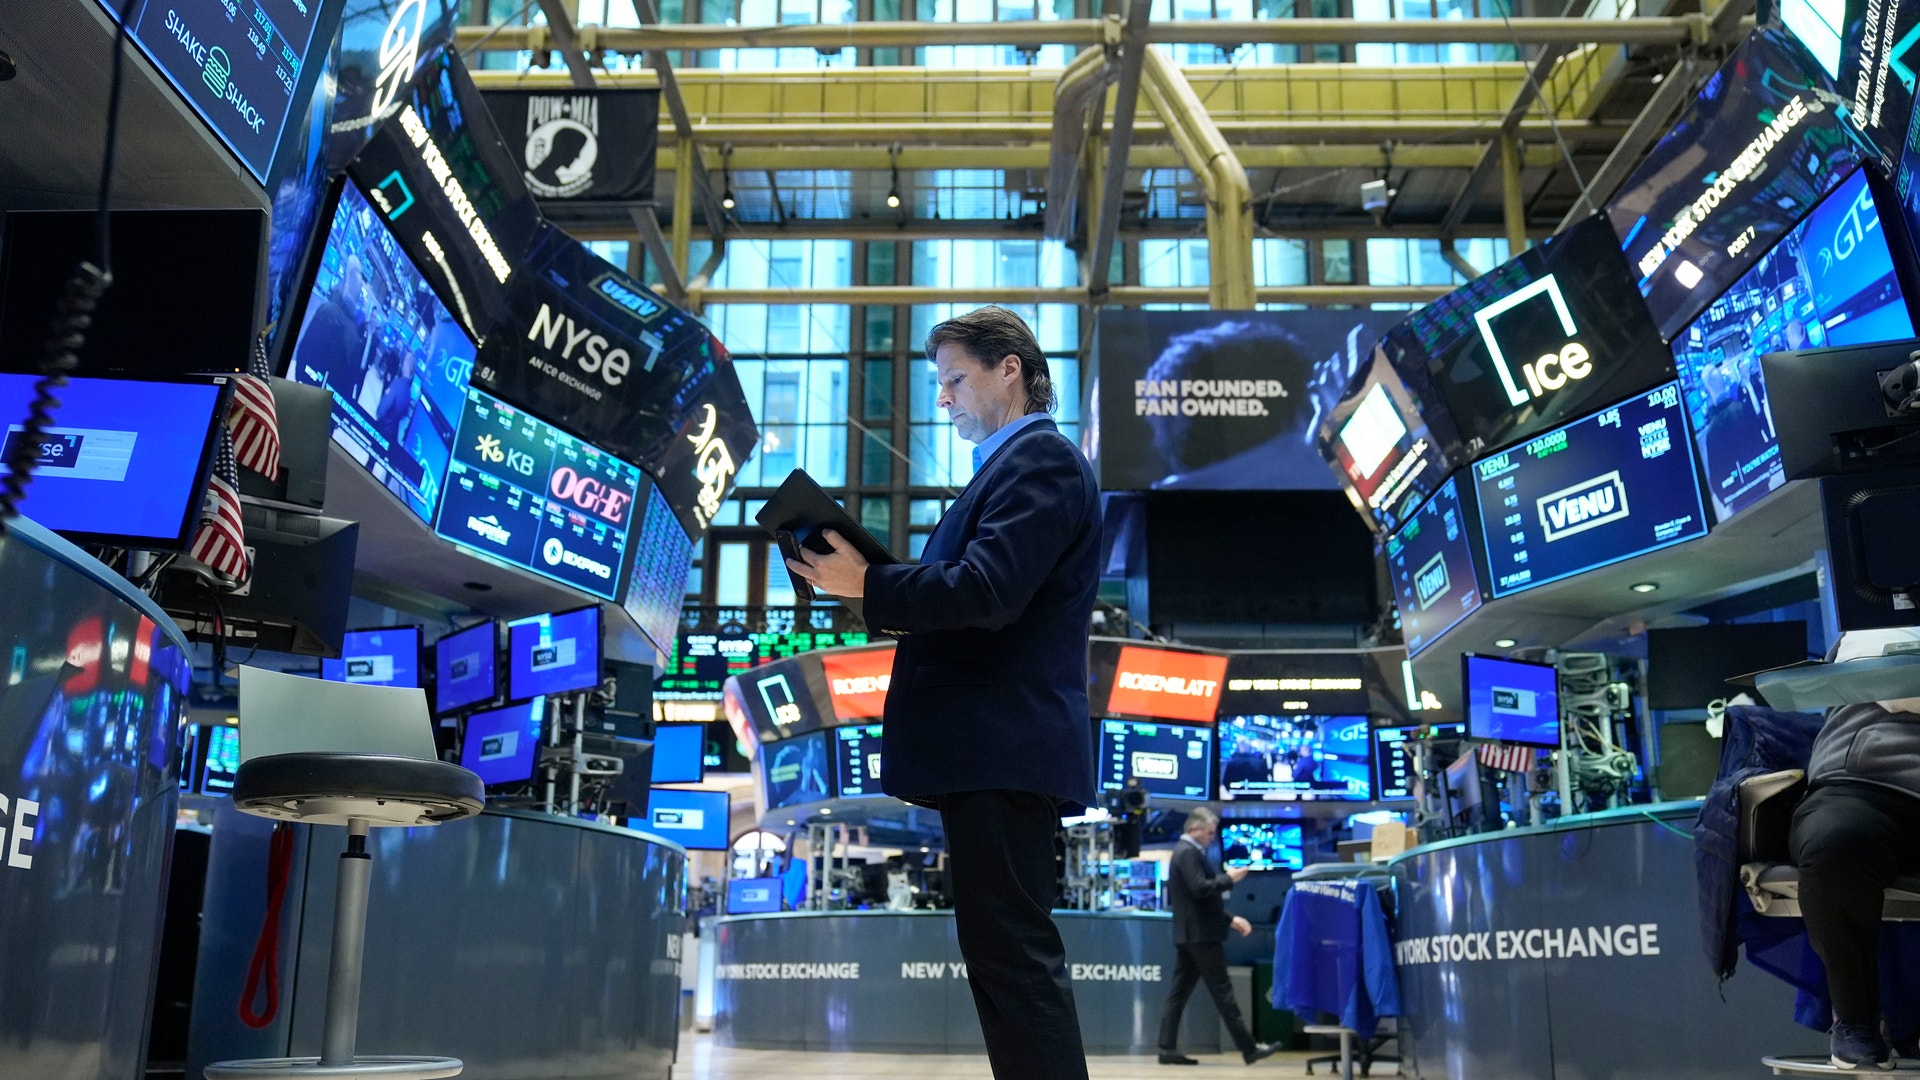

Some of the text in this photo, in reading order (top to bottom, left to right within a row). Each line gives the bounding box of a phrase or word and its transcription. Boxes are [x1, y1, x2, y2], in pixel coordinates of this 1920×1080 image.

[164, 9, 207, 67] SHAKE
[226, 81, 265, 135] SHACK
[570, 95, 598, 137] MIA
[399, 104, 511, 285] NEW YORK STOCK EXCHANGE
[1638, 95, 1808, 278] NEW YORK STOCK EXCHANGE
[1727, 226, 1756, 259] POST 7
[528, 356, 544, 370] AN
[1135, 380, 1288, 397] FAN FOUNDED.
[1648, 386, 1676, 407] 10.00
[1135, 399, 1269, 416] FAN OWNED.
[1638, 418, 1667, 436] VENU
[1470, 437, 1485, 450] 7A
[1641, 437, 1672, 459] NYSE
[507, 448, 535, 476] KB
[1479, 454, 1509, 476] VENU
[1547, 487, 1615, 529] VENU
[563, 550, 611, 579] EXPRO
[1419, 564, 1445, 600] VENU
[1118, 672, 1217, 697] ROSENBLATT
[1402, 936, 1431, 965] YORK
[1432, 932, 1492, 963] STOCK
[1496, 924, 1660, 960] EXCHANGE
[746, 963, 780, 979] STOCK
[781, 962, 860, 979] EXCHANGE
[901, 962, 945, 979] NEW
[1071, 963, 1162, 981] EXCHANGE
